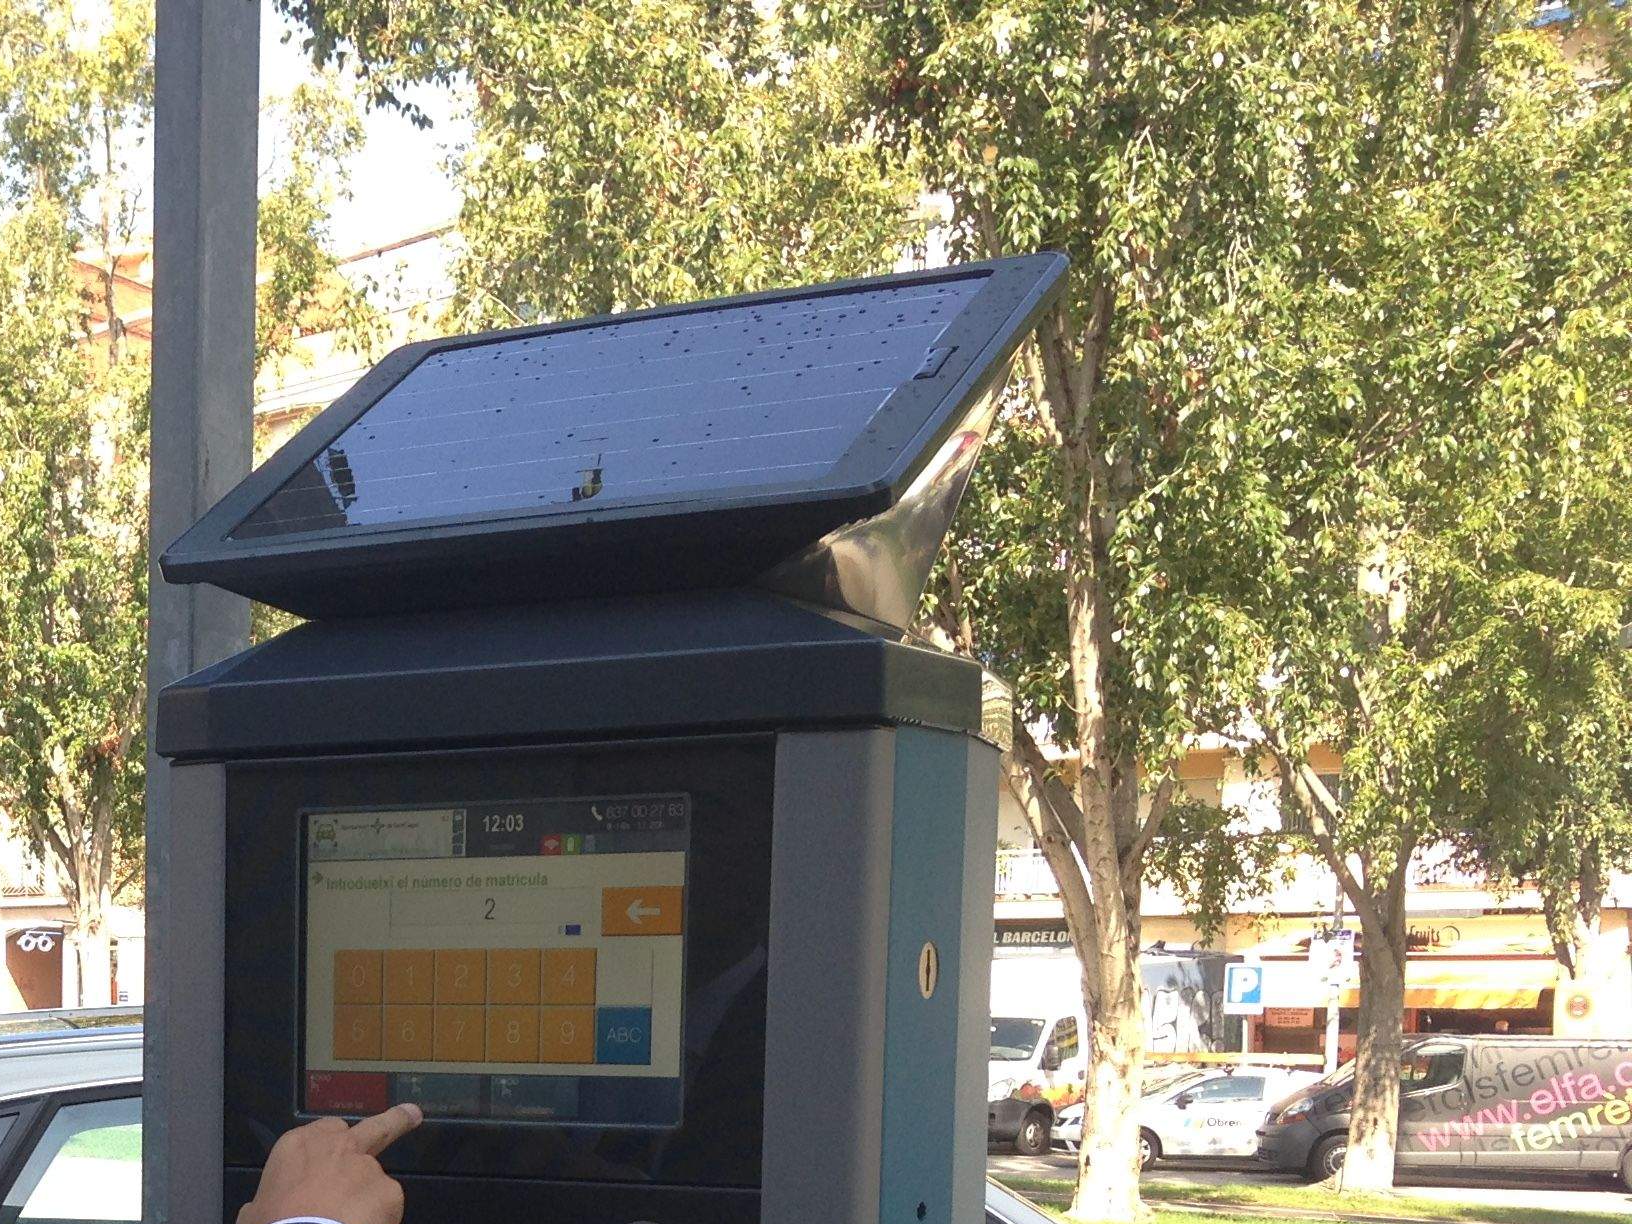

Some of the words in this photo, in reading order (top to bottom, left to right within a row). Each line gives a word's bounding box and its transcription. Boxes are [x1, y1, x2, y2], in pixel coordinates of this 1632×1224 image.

[481, 814, 525, 833] 12:03
[397, 874, 409, 889] el
[466, 872, 482, 887] de
[484, 898, 497, 921] 2
[351, 964, 366, 988] 0
[404, 965, 415, 987] 1
[453, 964, 469, 988] 2
[507, 963, 522, 988] 3
[560, 963, 576, 988] 4
[1230, 967, 1259, 1003] P
[401, 1019, 416, 1042] 6
[452, 1020, 466, 1042] 7
[505, 1020, 521, 1044] 8
[559, 1020, 575, 1044] 9
[606, 1026, 642, 1043] ABC
